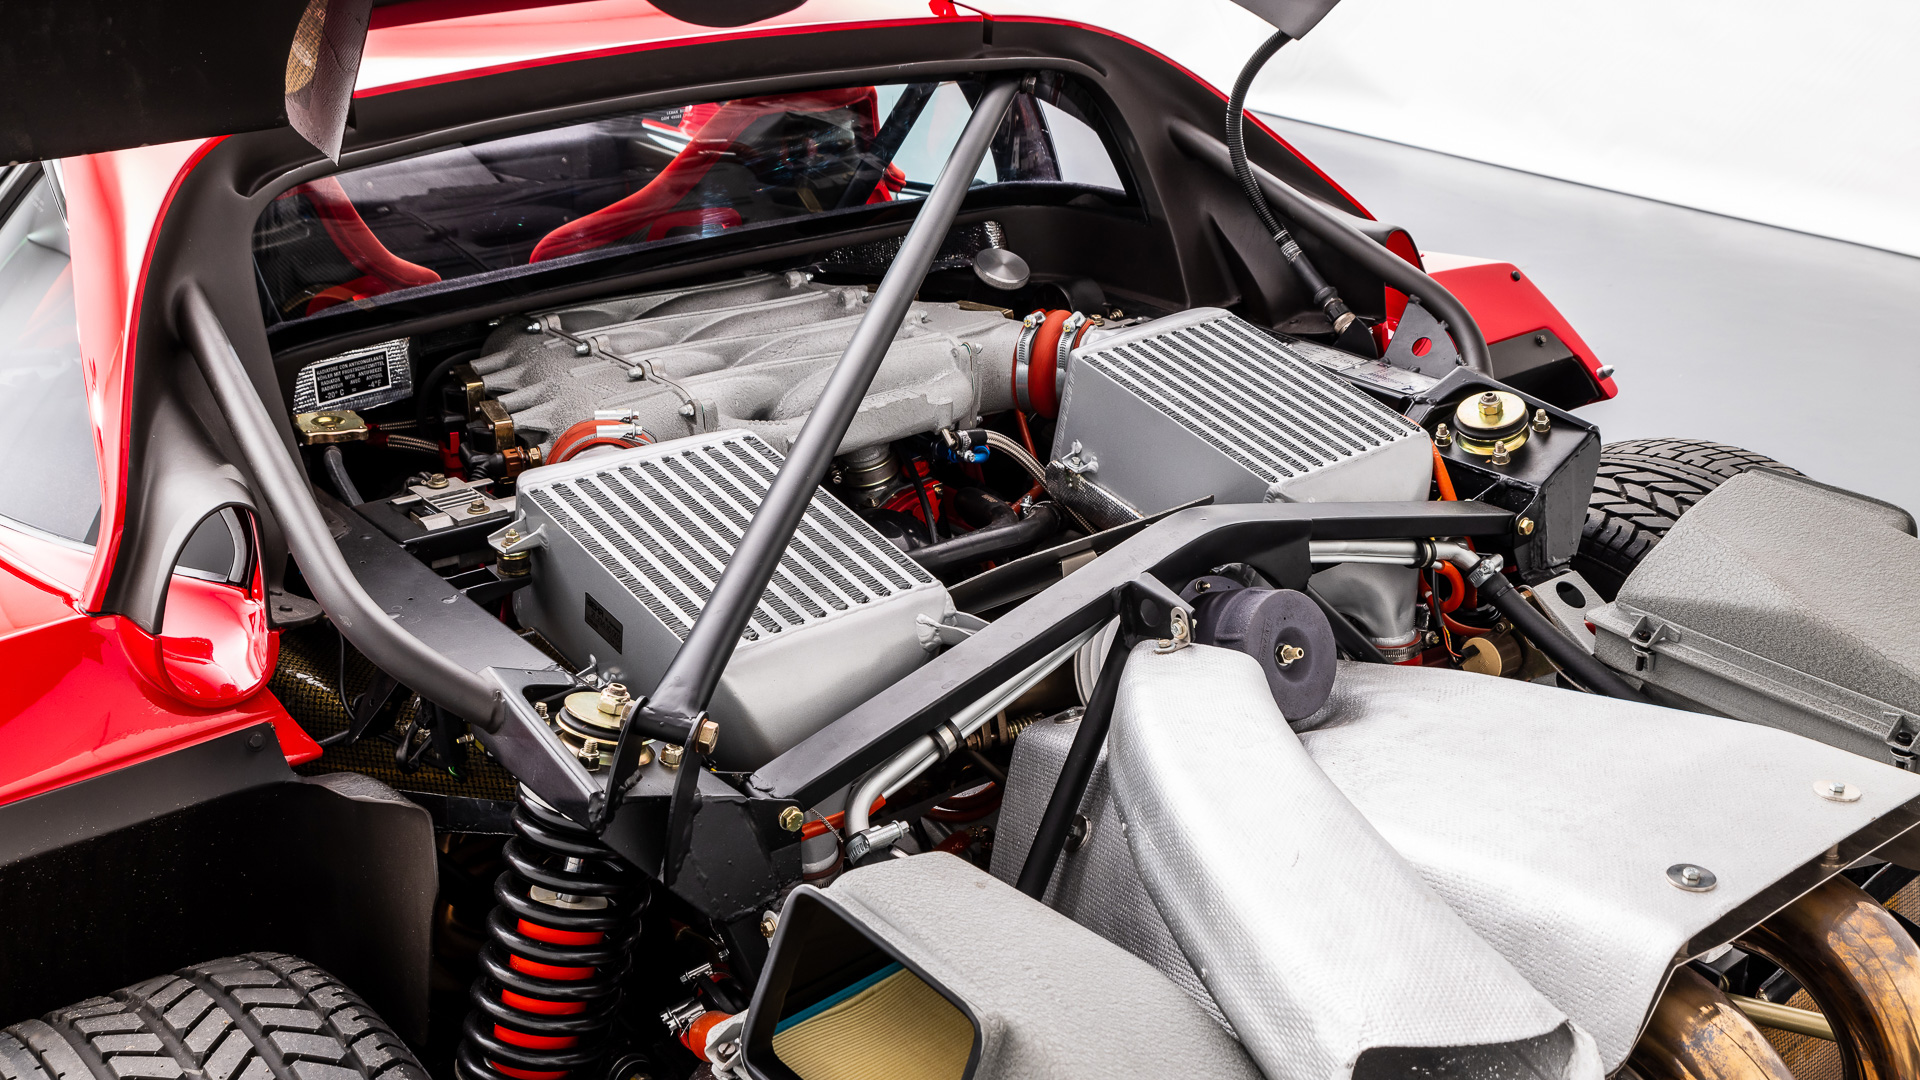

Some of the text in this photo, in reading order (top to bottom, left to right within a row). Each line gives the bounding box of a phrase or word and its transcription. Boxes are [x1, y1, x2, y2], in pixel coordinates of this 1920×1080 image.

[317, 366, 338, 375] RADIATORE
[349, 355, 383, 367] ANTICONGELANTE
[342, 361, 384, 374] FROSTSCHUTZMITTEL
[321, 377, 340, 386] RADIATOR
[358, 367, 382, 376] ANTIFREEZE
[321, 382, 343, 392] RADIATEUR
